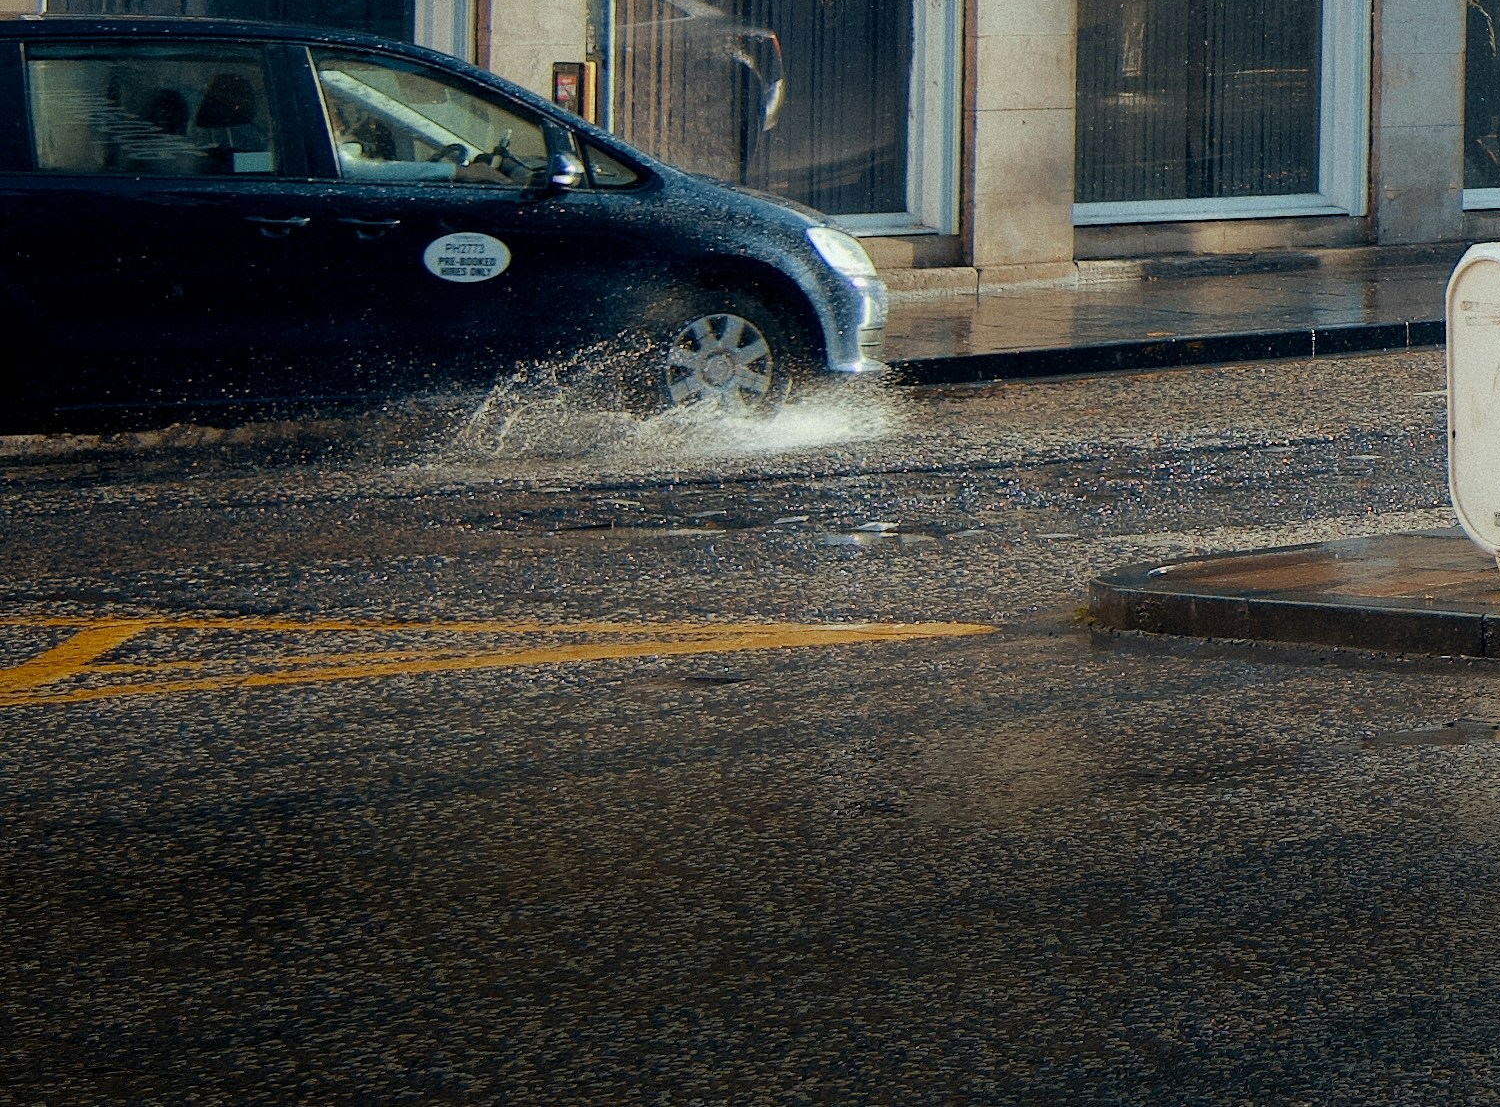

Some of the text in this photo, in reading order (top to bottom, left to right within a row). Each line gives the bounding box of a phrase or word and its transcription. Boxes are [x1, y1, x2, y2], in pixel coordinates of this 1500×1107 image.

[445, 243, 485, 254] PH2773
[438, 257, 497, 267] PRE-BOOKED
[440, 267, 492, 276] HIRES ONLY
